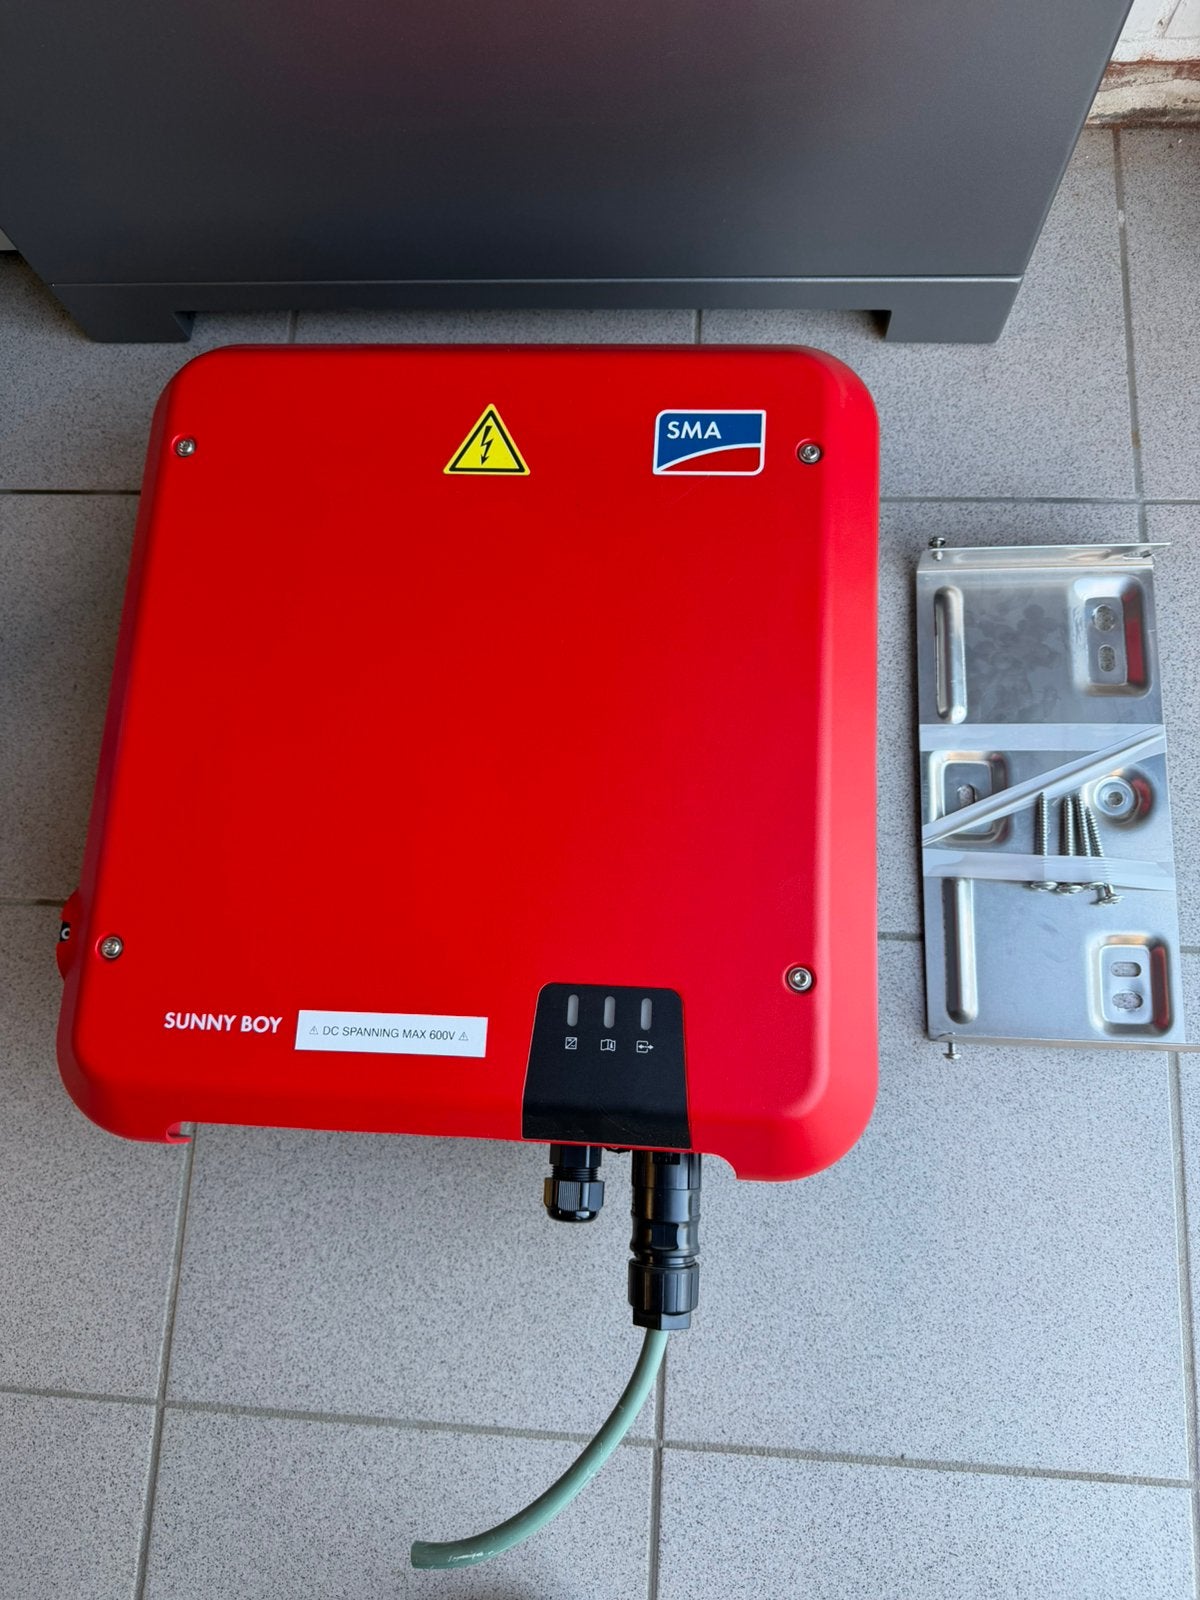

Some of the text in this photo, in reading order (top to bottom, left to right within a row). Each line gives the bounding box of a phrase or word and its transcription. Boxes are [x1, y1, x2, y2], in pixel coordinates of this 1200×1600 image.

[667, 421, 722, 439] SMA
[163, 1011, 283, 1033] SUNNY BOY
[322, 1025, 456, 1041] DC SPANNING MAX 600V
